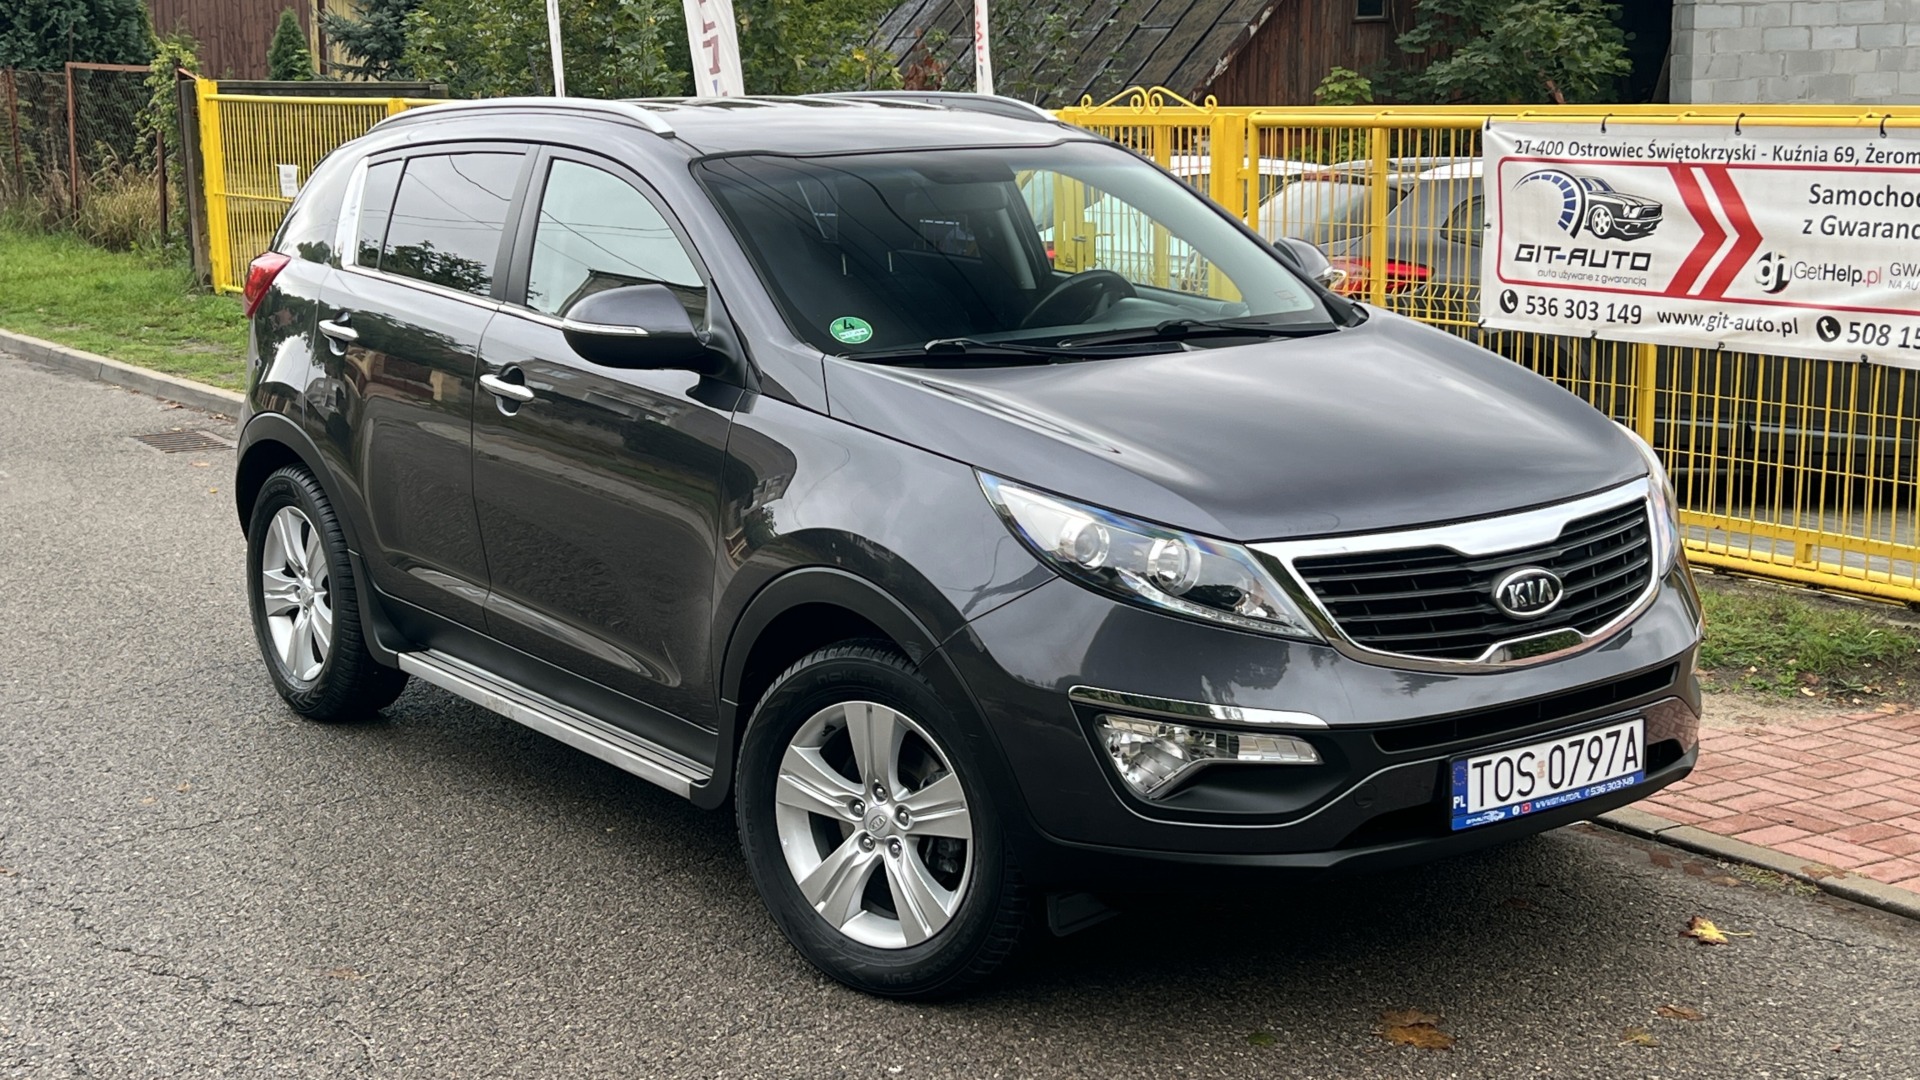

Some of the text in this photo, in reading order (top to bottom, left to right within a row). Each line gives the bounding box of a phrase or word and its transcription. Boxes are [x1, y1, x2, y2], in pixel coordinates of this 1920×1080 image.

[1514, 139, 1564, 156] 27-400
[1568, 141, 1643, 158] Ostrowiec
[1647, 139, 1756, 165] Świętokrzyski
[1772, 145, 1828, 163] Kuźnia
[1834, 146, 1859, 166] 69,
[1802, 219, 1813, 235] z
[1514, 243, 1652, 271] GIT-AUTO
[1558, 270, 1594, 282] używane
[1595, 274, 1600, 282] z
[1793, 261, 1882, 288] GetHelp.pl
[1887, 279, 1902, 289] NA
[1525, 295, 1642, 325] 536 303 149
[1657, 311, 1799, 338] www.git-auto.pl
[1847, 321, 1892, 347] 508
[1507, 578, 1554, 609] KIA
[1472, 726, 1639, 808] TOS 0797A
[1453, 796, 1466, 809] PL
